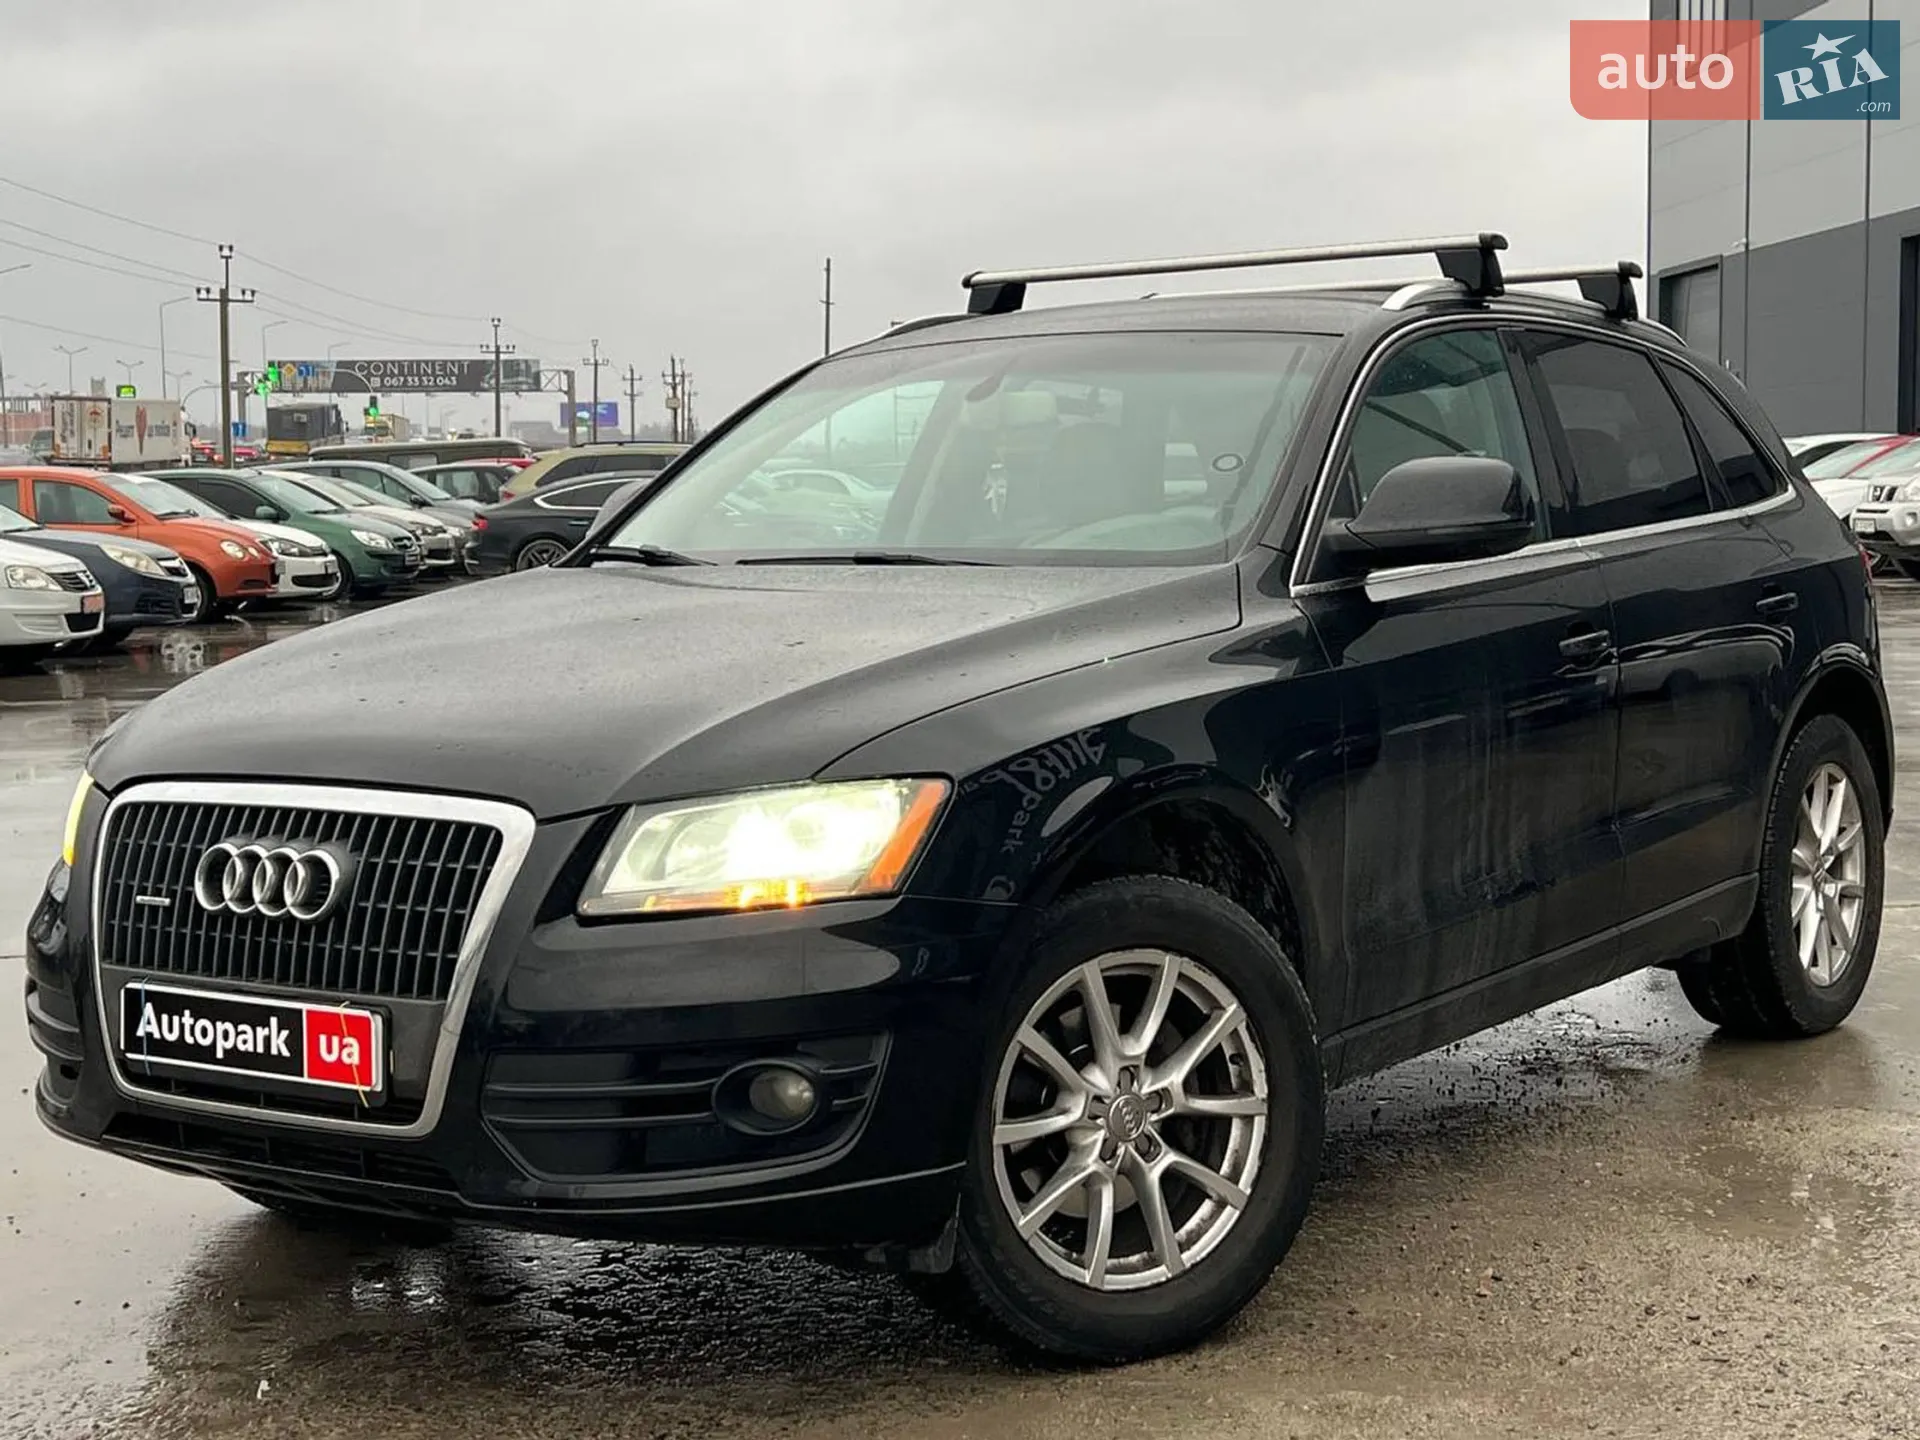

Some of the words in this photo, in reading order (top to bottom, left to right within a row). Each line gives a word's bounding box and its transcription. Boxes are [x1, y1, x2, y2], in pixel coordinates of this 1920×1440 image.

[354, 361, 469, 375] CONTINENT
[383, 376, 405, 386] 067
[406, 376, 420, 386] 33
[421, 376, 435, 386] 32
[136, 1001, 291, 1059] Autopark
[318, 1034, 360, 1065] ua
